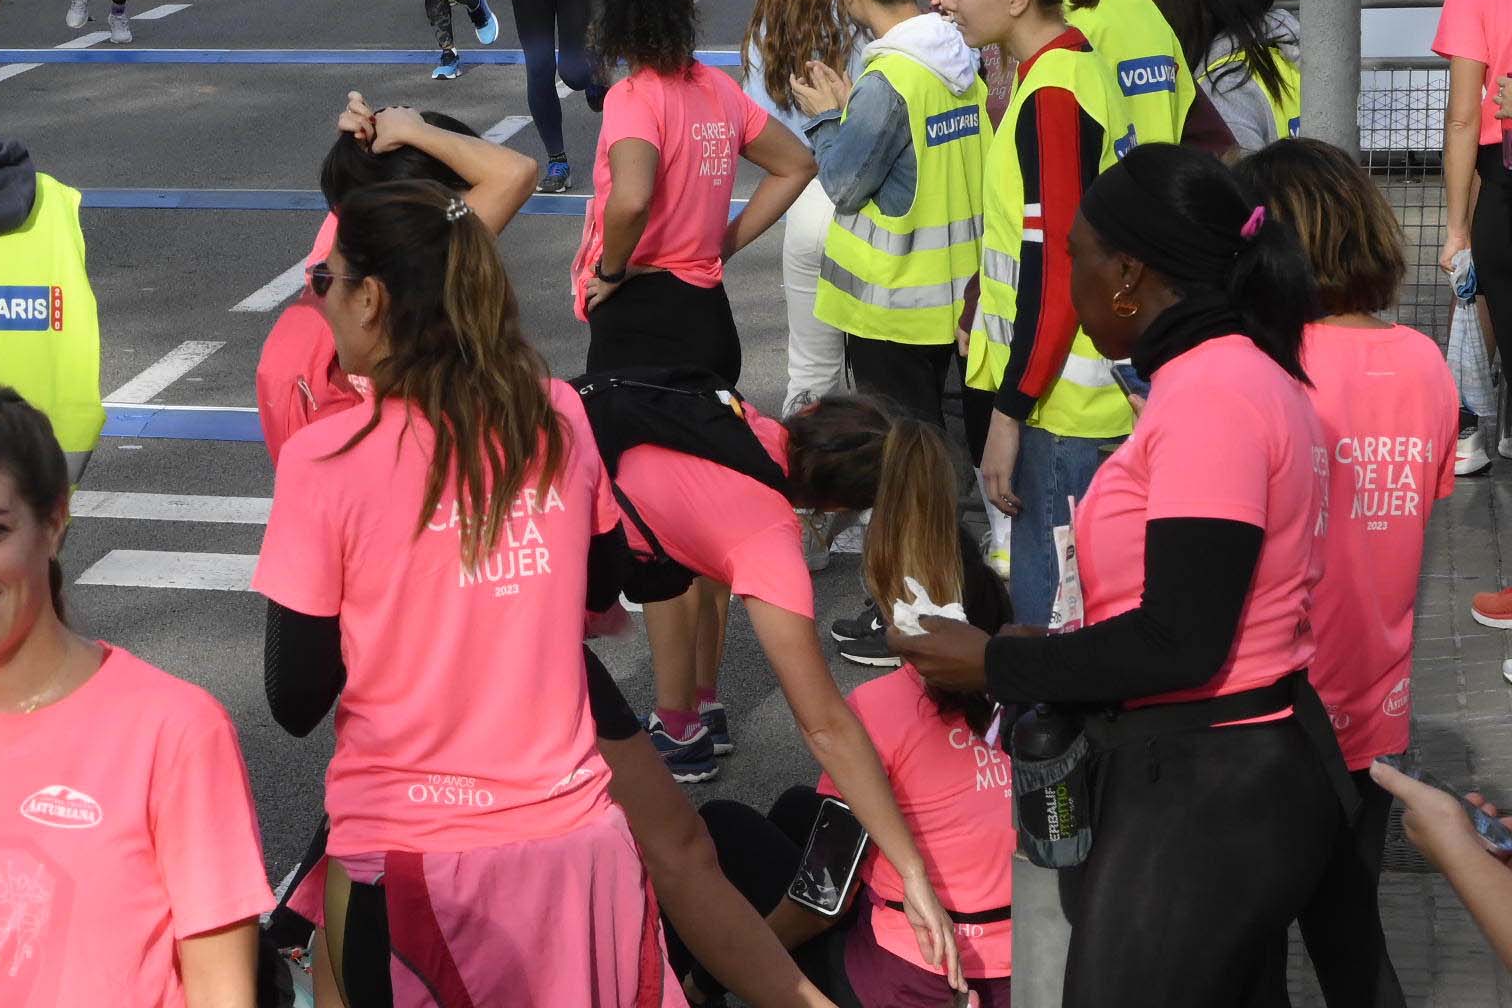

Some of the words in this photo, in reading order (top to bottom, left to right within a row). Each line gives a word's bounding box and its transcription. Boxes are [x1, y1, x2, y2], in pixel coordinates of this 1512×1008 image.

[691, 122, 736, 140] CARREA
[702, 142, 716, 157] DE
[1335, 437, 1432, 464] CARRERA
[1386, 464, 1416, 489] LA
[507, 518, 543, 547] LA
[1367, 521, 1388, 530] 2023
[459, 548, 552, 587] MUJER
[495, 584, 519, 597] 2023
[408, 784, 494, 807] OYSHO
